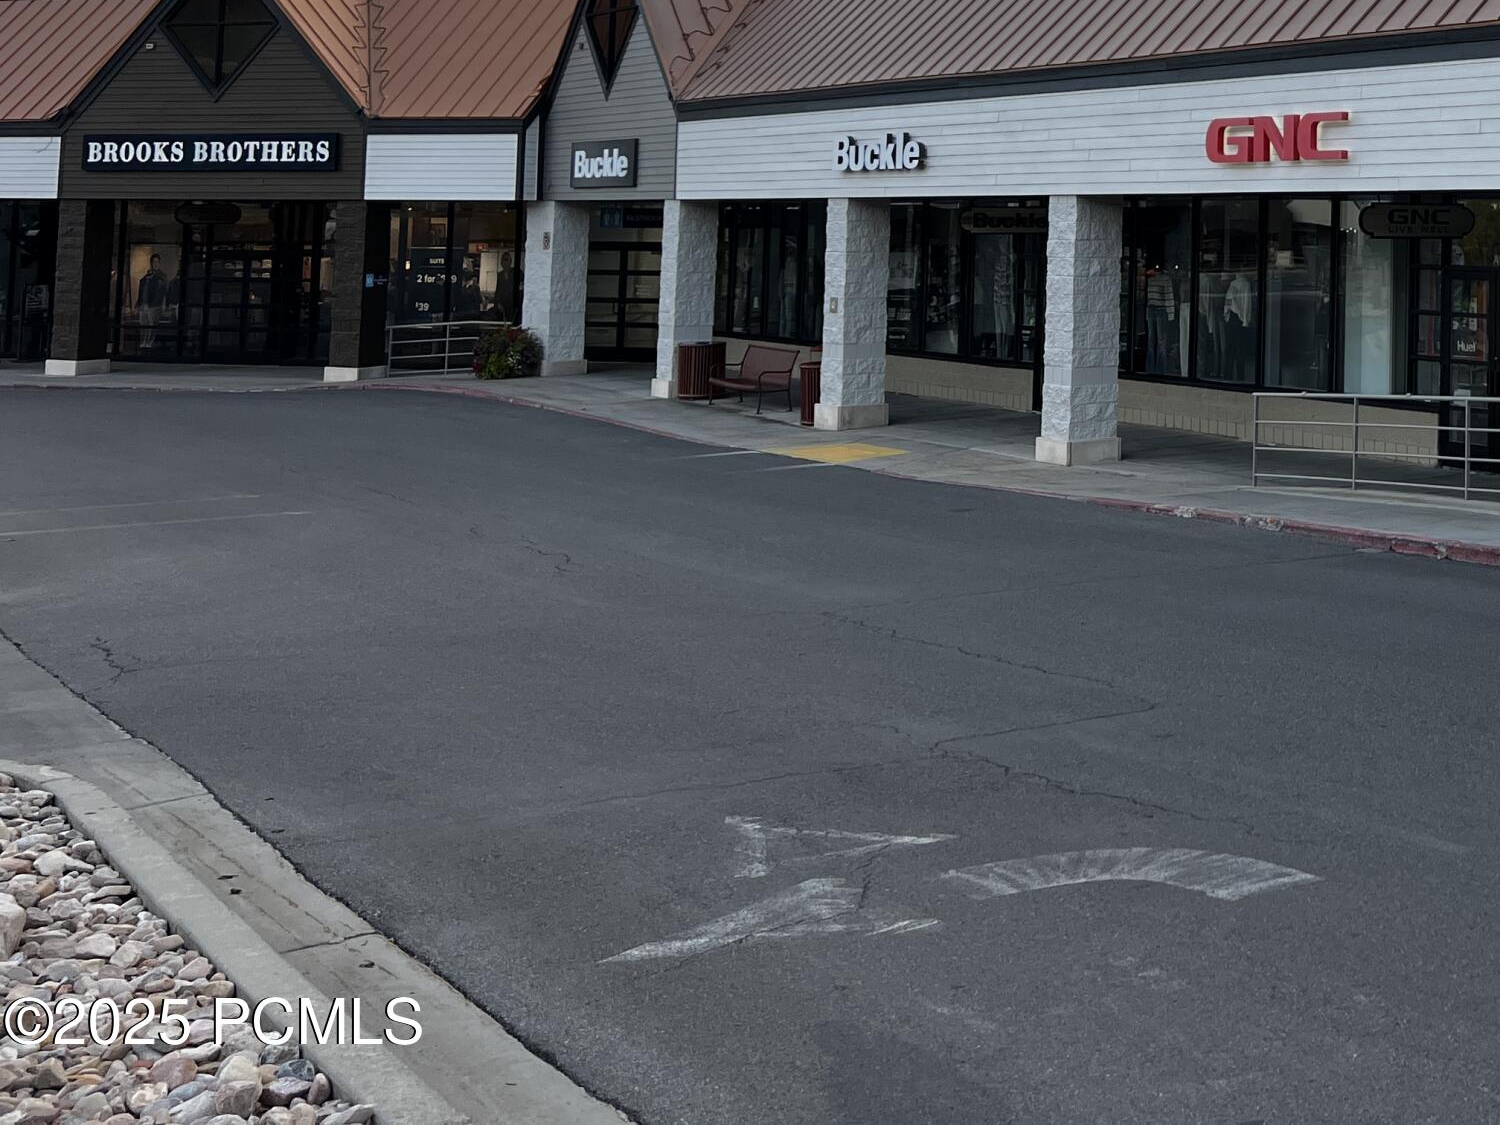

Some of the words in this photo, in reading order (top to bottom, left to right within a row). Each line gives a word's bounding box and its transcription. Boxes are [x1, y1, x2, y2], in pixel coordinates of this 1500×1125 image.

[1205, 111, 1349, 163] GNC
[87, 141, 184, 163] BROOKS
[192, 140, 330, 162] BROTHERS
[574, 147, 629, 178] Buckle
[833, 131, 921, 171] Buckle
[1388, 208, 1450, 225] GNC
[1456, 339, 1477, 353] Huel
